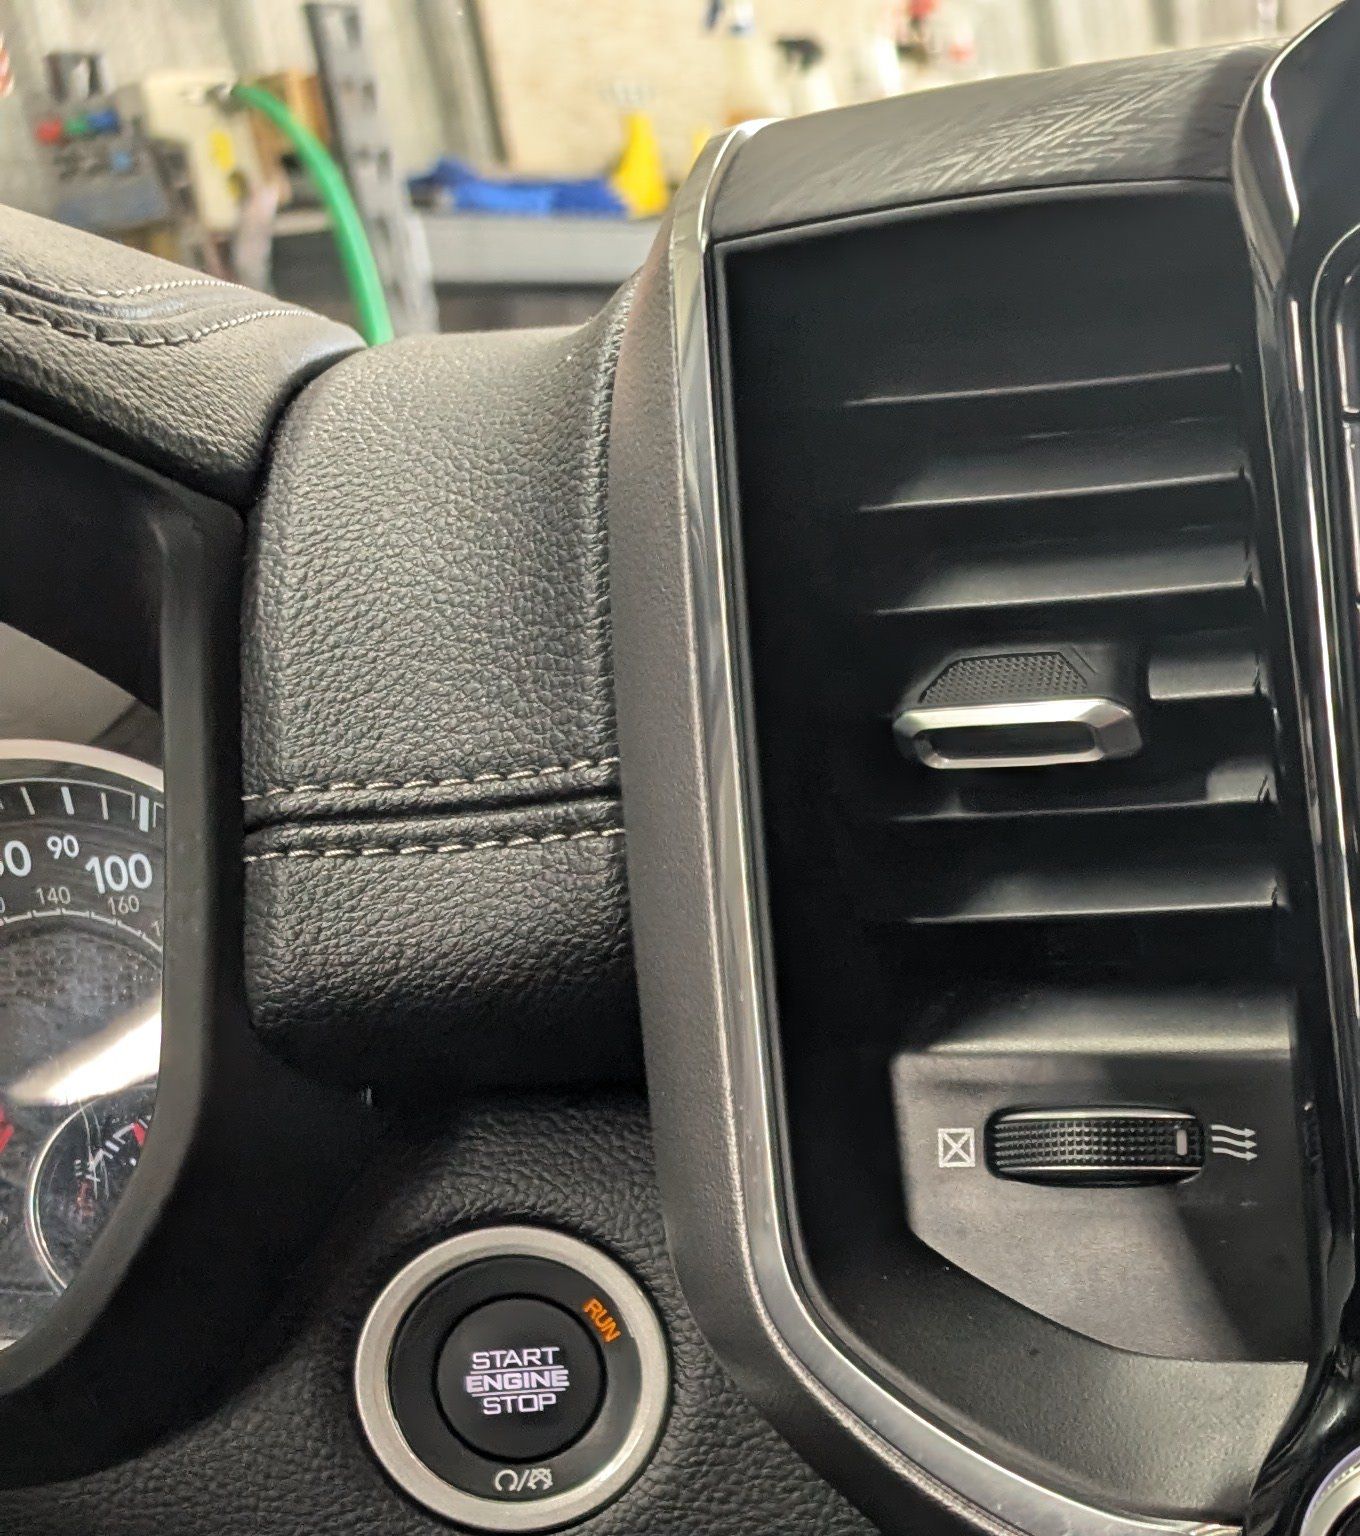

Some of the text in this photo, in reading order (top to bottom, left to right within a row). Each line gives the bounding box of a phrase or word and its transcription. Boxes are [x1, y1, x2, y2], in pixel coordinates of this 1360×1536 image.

[0, 840, 32, 877] 0
[46, 835, 79, 860] 90
[85, 853, 153, 894] 100
[36, 886, 71, 905] 140
[107, 895, 140, 916] 160
[582, 1298, 622, 1343] RUN
[472, 1347, 560, 1369] START
[465, 1369, 570, 1393] ENGINE
[482, 1393, 557, 1415] STOP
